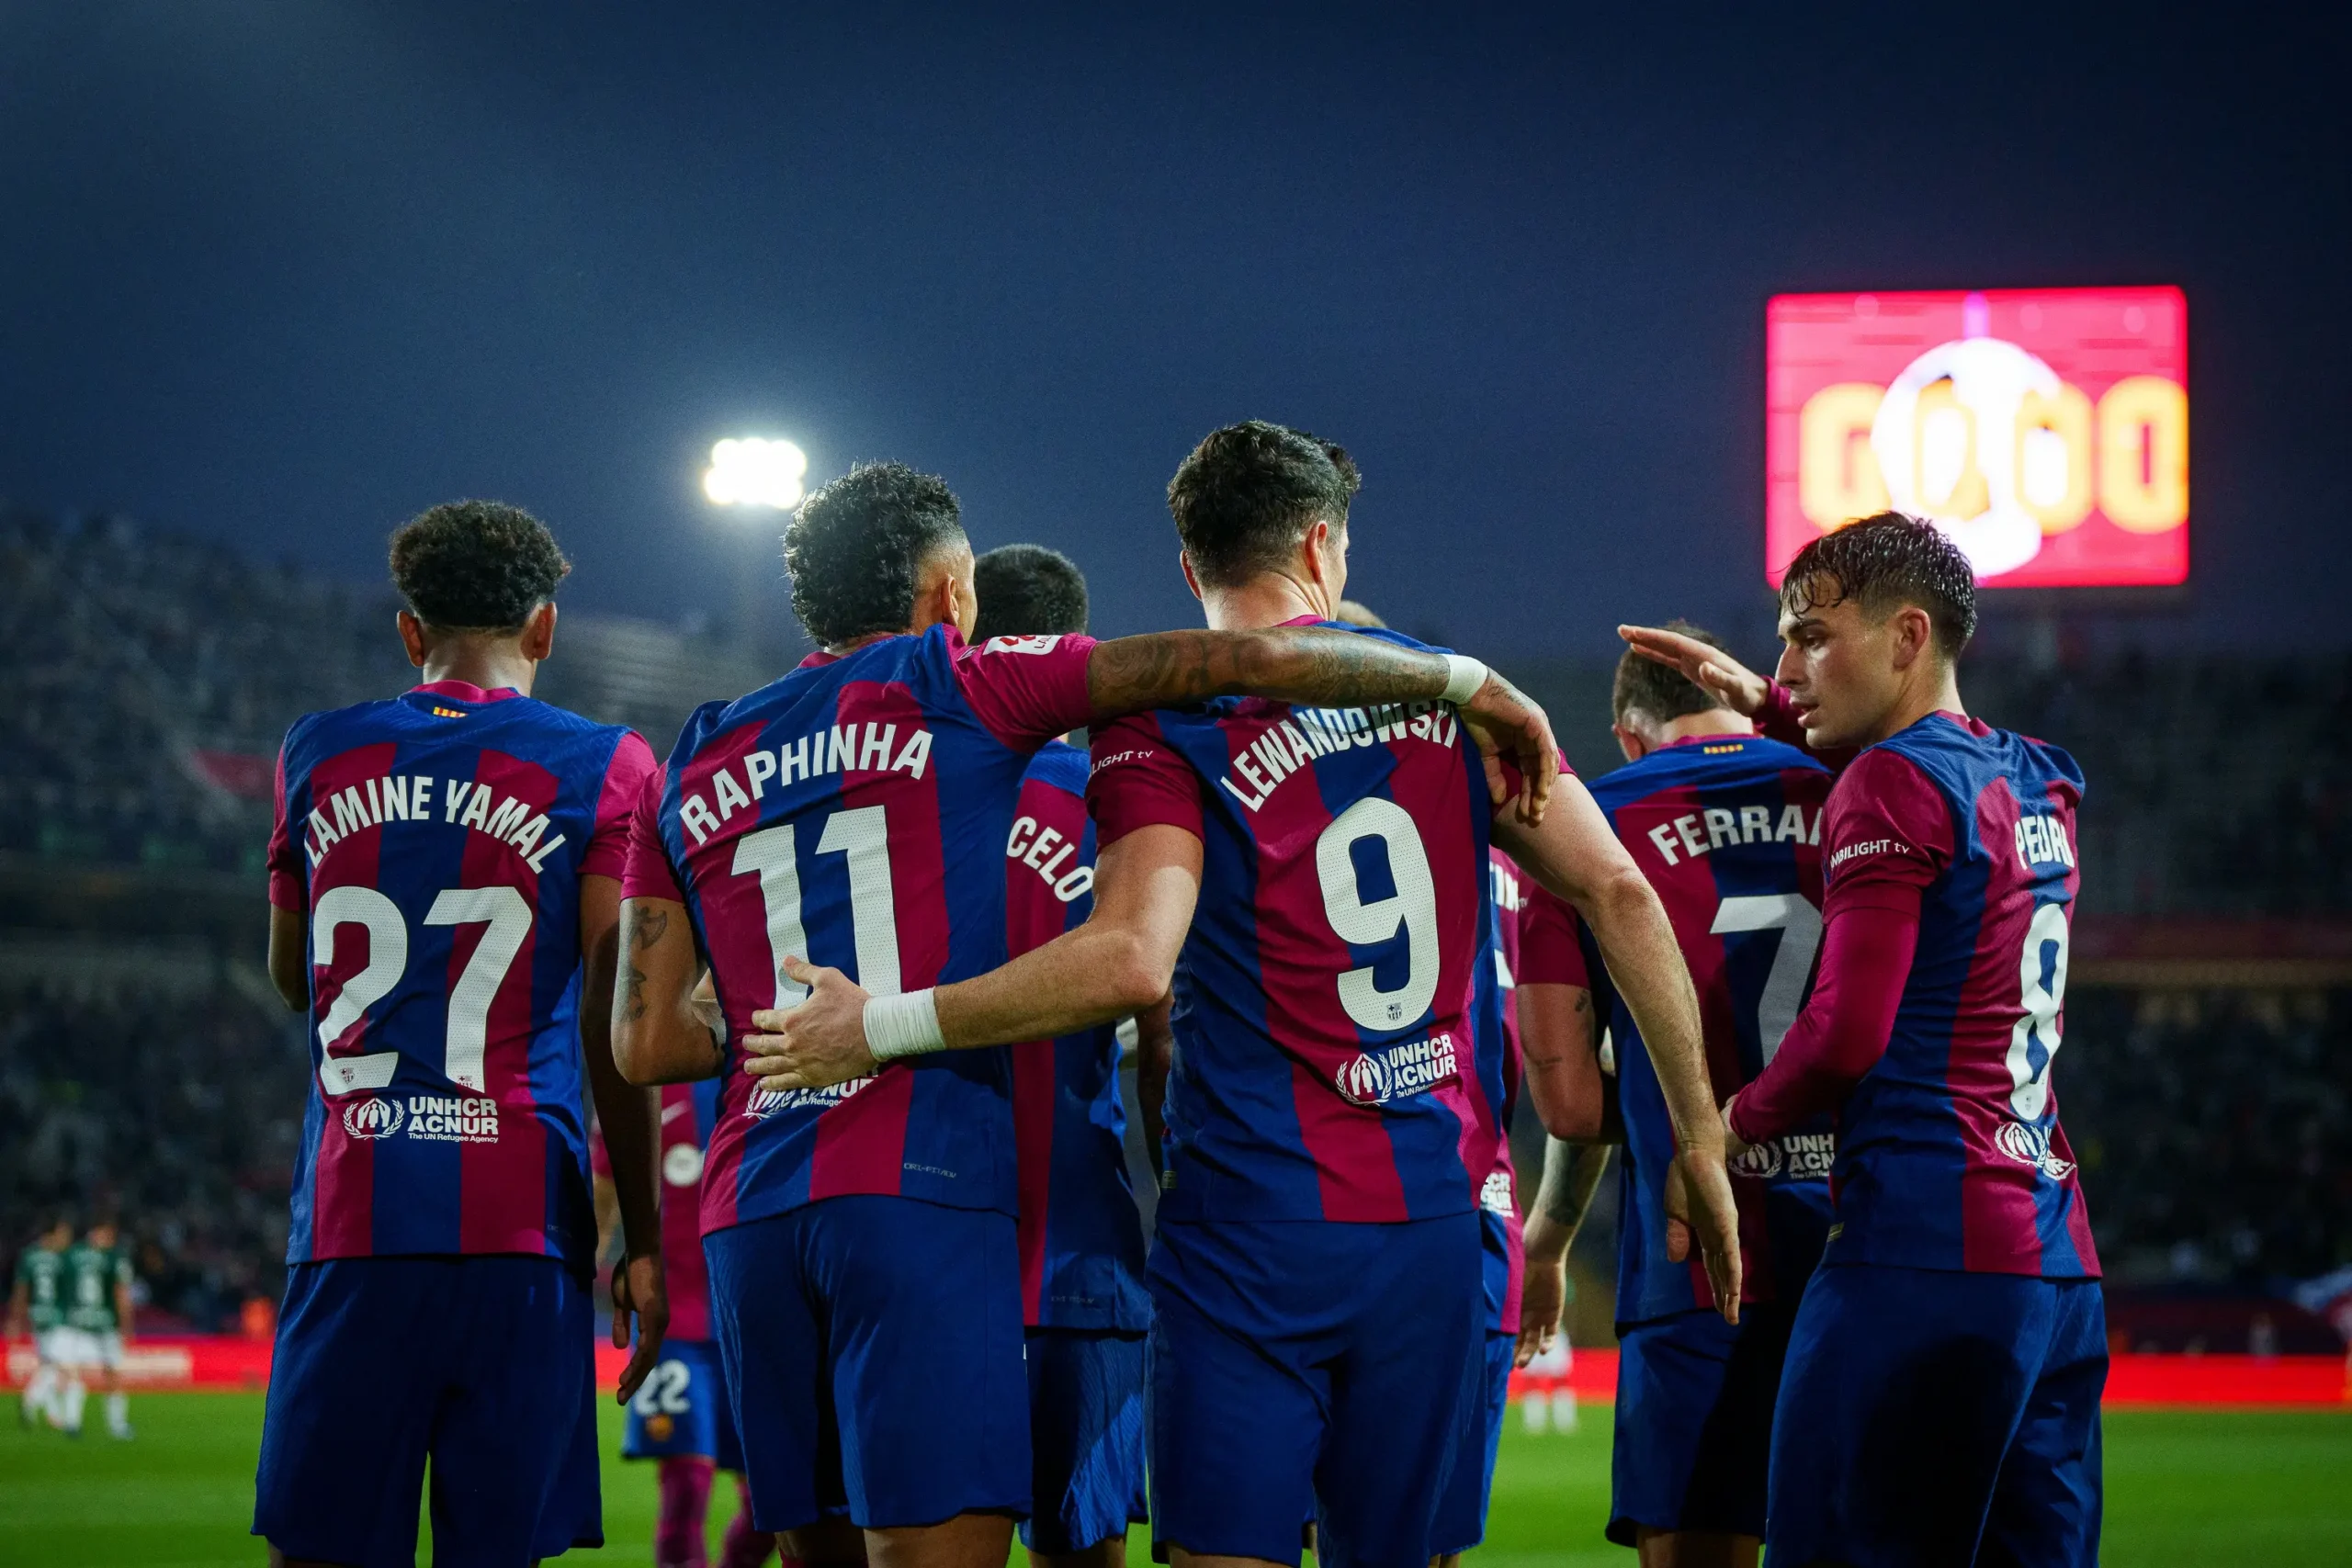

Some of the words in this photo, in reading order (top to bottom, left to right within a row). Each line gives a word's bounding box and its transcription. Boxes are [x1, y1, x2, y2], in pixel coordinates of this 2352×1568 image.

[1090, 750, 1134, 778] LIGHT
[1137, 750, 1153, 760] tv
[679, 722, 933, 846] RAPHINHA
[304, 775, 434, 869] LAMINE
[445, 779, 567, 874] YAMAL
[1894, 842, 1910, 854] tv
[730, 805, 902, 1010] 11
[1316, 796, 1440, 1032] 9
[313, 886, 533, 1096] 27
[1709, 893, 1824, 1070] 7
[2006, 903, 2068, 1122] 8
[1388, 1033, 1454, 1068] UNHCR
[1395, 1054, 1458, 1090] ACNUR
[409, 1096, 499, 1117] UNHCR
[407, 1115, 499, 1135] ACNUR
[437, 1134, 469, 1143] Refugee
[469, 1135, 499, 1144] Agency
[1783, 1133, 1835, 1154] UNH
[1788, 1152, 1836, 1173] ACN
